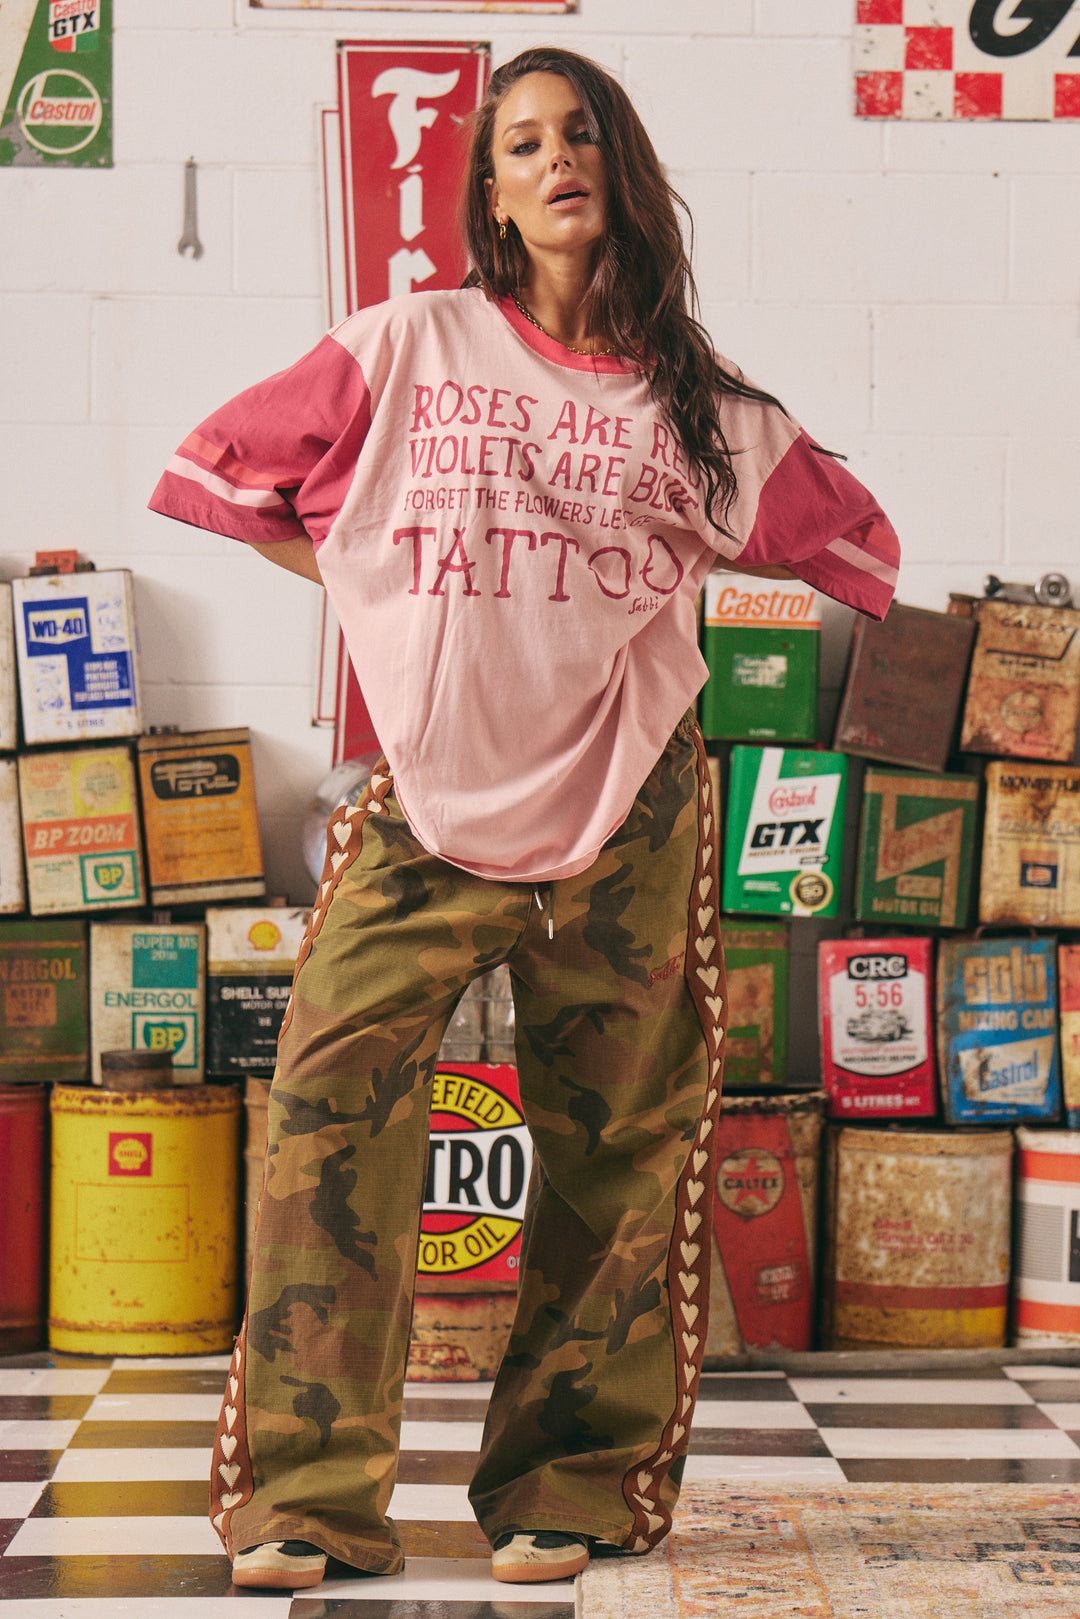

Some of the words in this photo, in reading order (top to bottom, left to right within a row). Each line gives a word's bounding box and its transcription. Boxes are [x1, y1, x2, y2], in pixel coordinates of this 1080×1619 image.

[53, 11, 95, 38] GTX
[30, 100, 97, 122] Castrol
[409, 380, 539, 433] ROSES
[547, 400, 634, 450] ARE
[408, 435, 543, 482] VIOLETS
[548, 451, 626, 497] ARE
[403, 487, 469, 511] FORGET
[475, 487, 510, 511] THE
[515, 490, 597, 525] FLOWERS
[392, 526, 685, 603] TATTOO
[716, 587, 815, 619] Castrol
[32, 616, 84, 638] WD-40
[769, 784, 819, 818] Castrol
[33, 827, 65, 850] BP
[64, 820, 128, 848] ZOOM
[750, 818, 827, 849] GTX
[97, 865, 122, 887] BP
[133, 936, 175, 950] SUPER
[177, 937, 198, 950] MS
[850, 956, 906, 979] CRC
[104, 991, 200, 1009] ENERGOL
[221, 986, 264, 1000] SHELL
[958, 1009, 1018, 1032] MIXING
[1022, 1008, 1057, 1030] CAN
[149, 1026, 185, 1050] BP
[978, 1050, 1039, 1092] Castrol
[854, 1094, 904, 1108] LITRES
[723, 1177, 779, 1190] CALTEX
[464, 1222, 506, 1258] OIL
